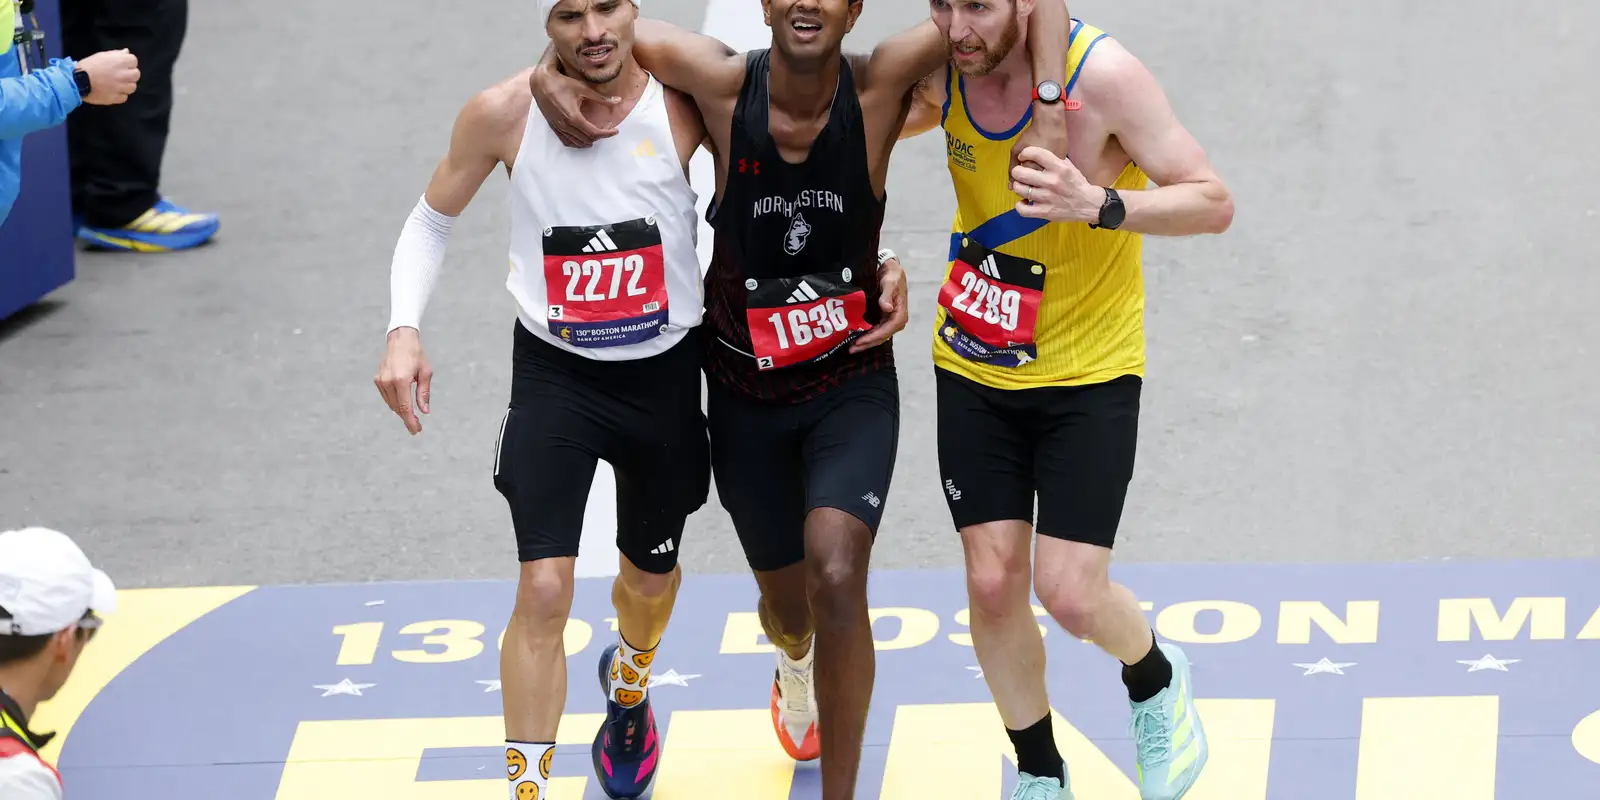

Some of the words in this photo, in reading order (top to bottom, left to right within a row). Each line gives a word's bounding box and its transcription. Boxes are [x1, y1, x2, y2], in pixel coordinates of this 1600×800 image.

[562, 254, 647, 302] 2272
[551, 307, 561, 318] 3
[951, 271, 1021, 331] 2289
[591, 326, 620, 336] BOSTON
[621, 319, 659, 333] MARATHON
[767, 298, 849, 350] 1636
[760, 358, 771, 368] 2
